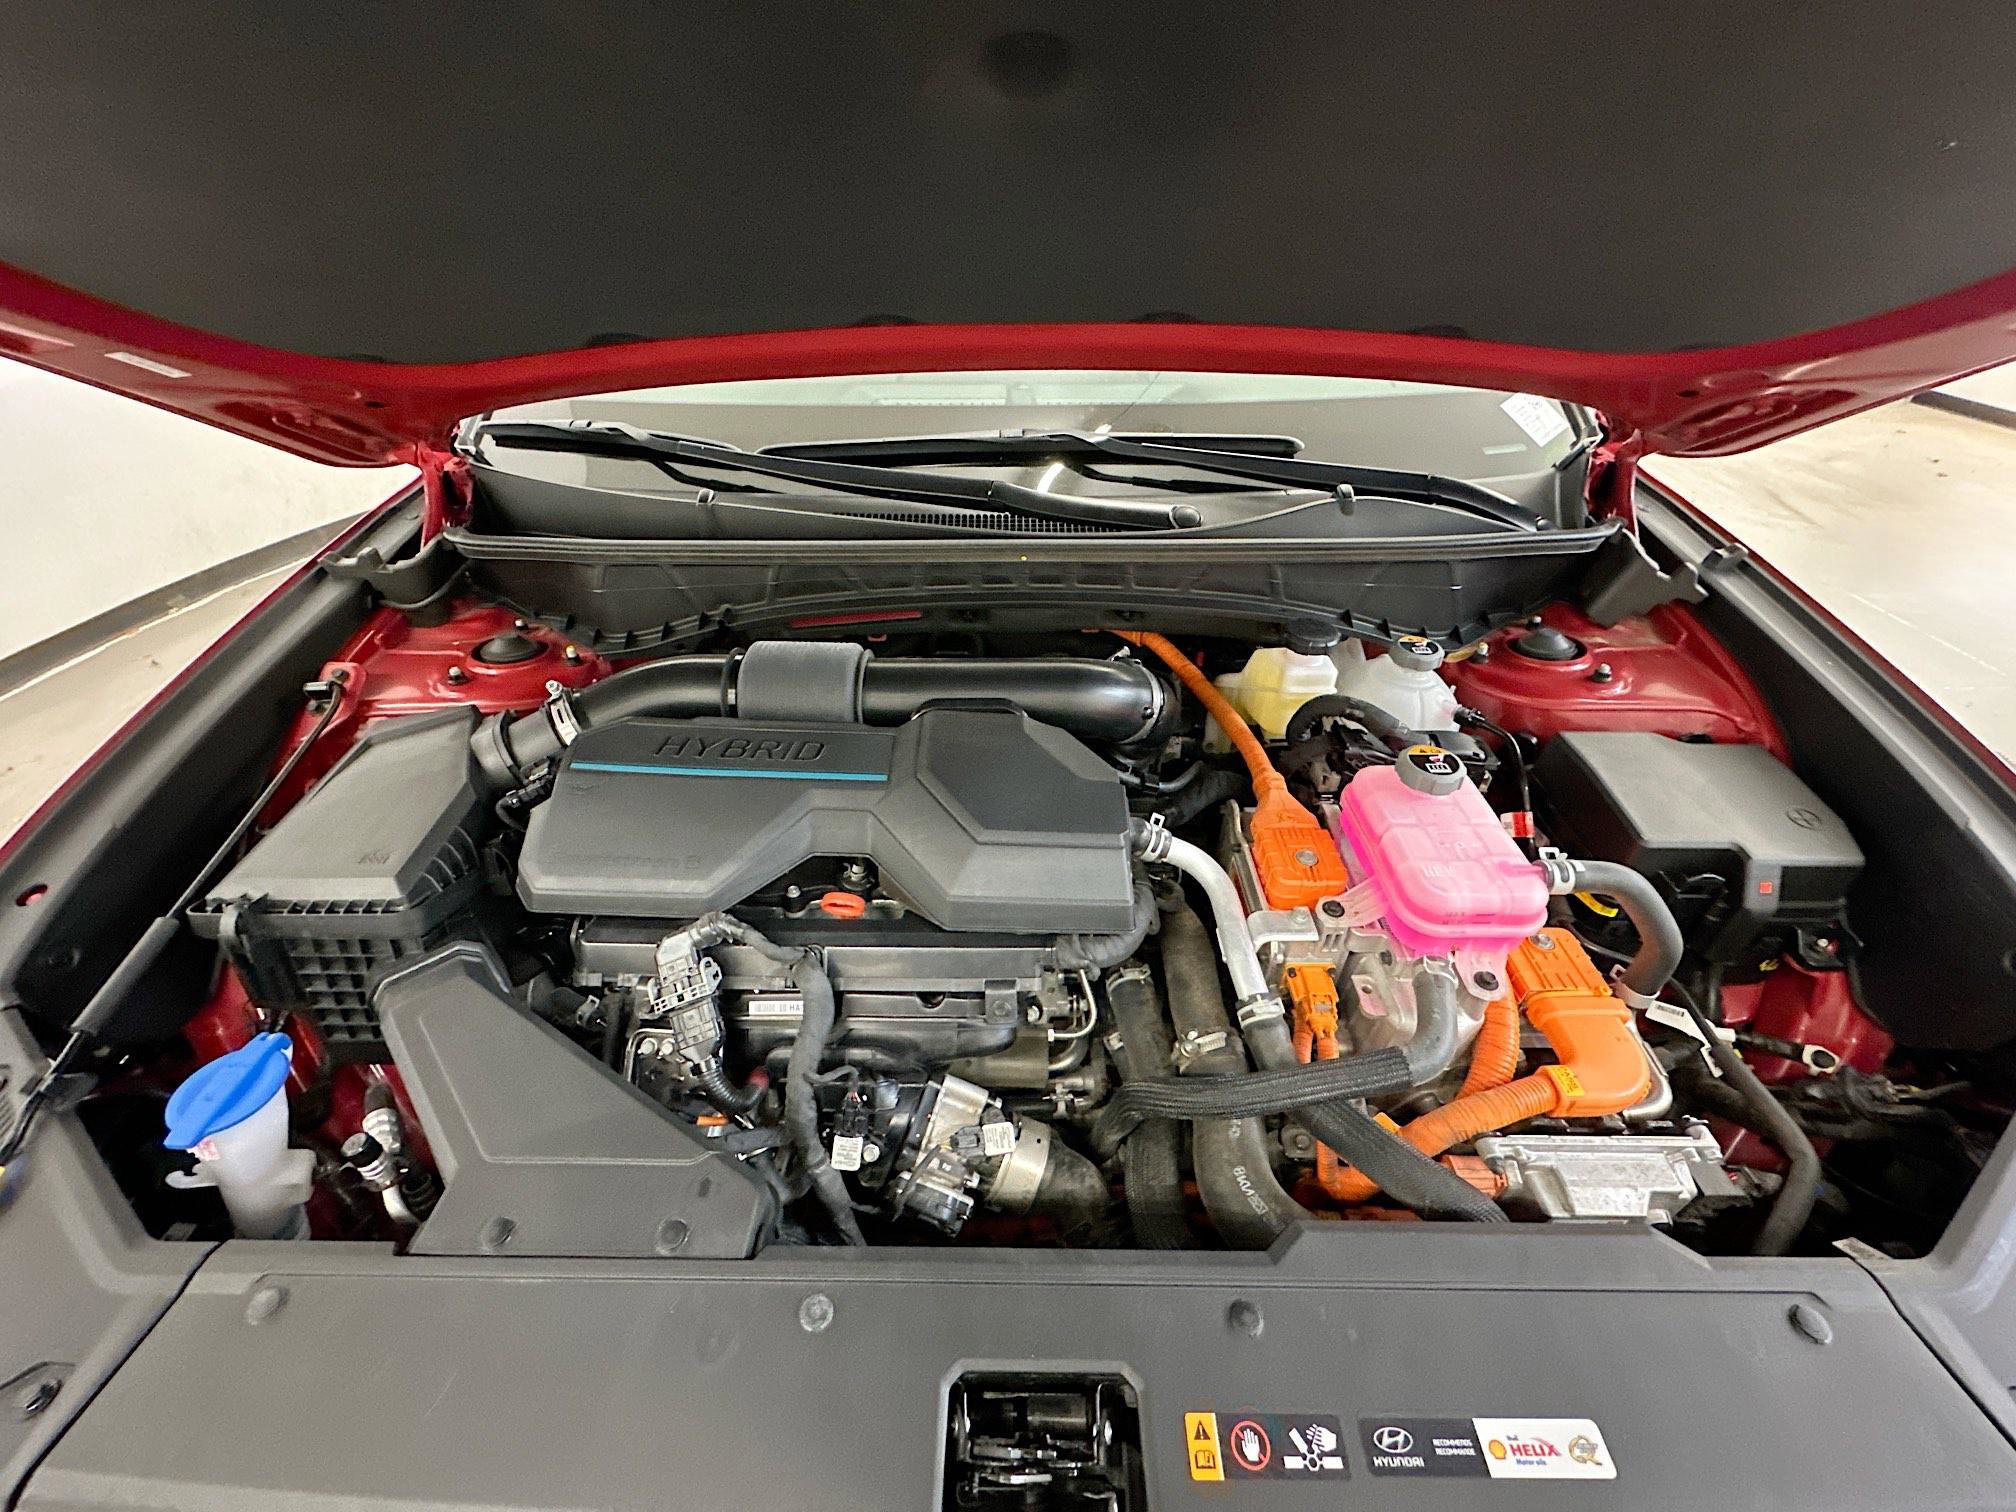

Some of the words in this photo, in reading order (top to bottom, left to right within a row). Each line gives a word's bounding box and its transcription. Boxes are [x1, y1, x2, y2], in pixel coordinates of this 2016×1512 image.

[654, 735, 827, 762] HYBRID
[1508, 1443, 1562, 1457] HELIX
[1372, 1456, 1425, 1468] HYUNDAI
